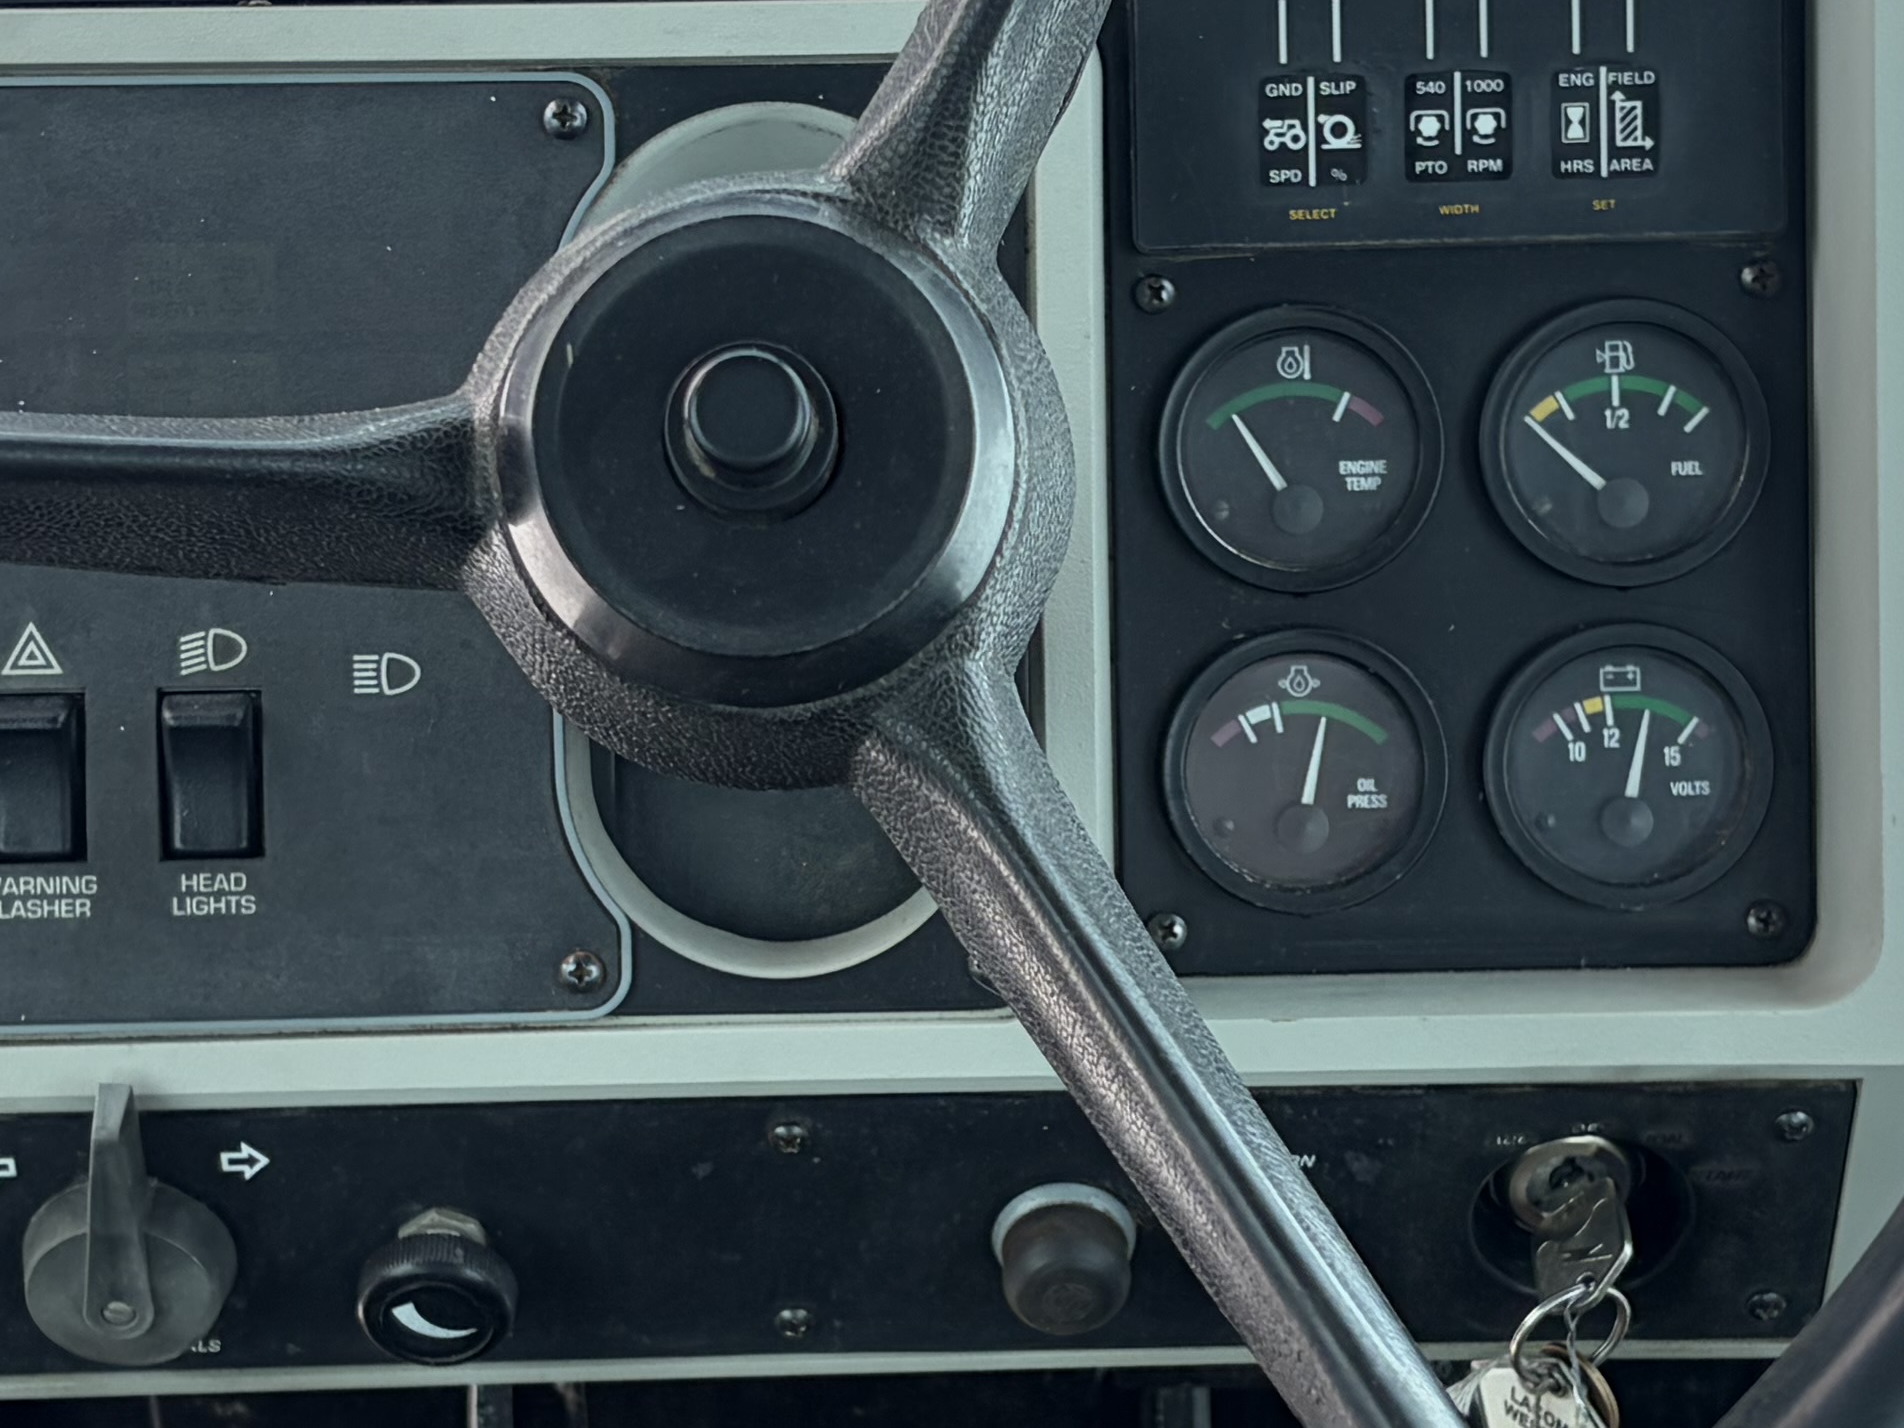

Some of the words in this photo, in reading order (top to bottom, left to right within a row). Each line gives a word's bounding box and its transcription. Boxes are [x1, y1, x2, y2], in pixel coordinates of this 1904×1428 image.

[1559, 73, 1594, 86] ENG
[1607, 70, 1656, 87] FIELD
[1266, 83, 1302, 97] GND
[1320, 81, 1356, 95] SLIP
[1417, 81, 1445, 94] 540
[1466, 79, 1504, 92] 1000
[1416, 161, 1447, 174] PTO
[1468, 159, 1502, 172] RPM
[1561, 159, 1594, 172] HRS
[1610, 159, 1653, 171] AREA
[1270, 170, 1302, 183] SPD
[1439, 204, 1479, 214] WIDTH
[1593, 199, 1615, 210] SET
[1289, 208, 1335, 220] SELECT
[1605, 409, 1629, 428] 1/2
[1339, 460, 1386, 476] ENGINE
[1672, 461, 1702, 475] FUEL
[1346, 477, 1380, 490] TEMP
[1603, 728, 1619, 747] 12
[1569, 742, 1585, 761] 10
[1664, 745, 1682, 767] 15
[1357, 778, 1376, 791] OIL
[1671, 781, 1709, 795] VOLTS
[1348, 795, 1386, 808] PRESS
[182, 873, 246, 892] HEAD
[173, 896, 256, 915] LIGHTS
